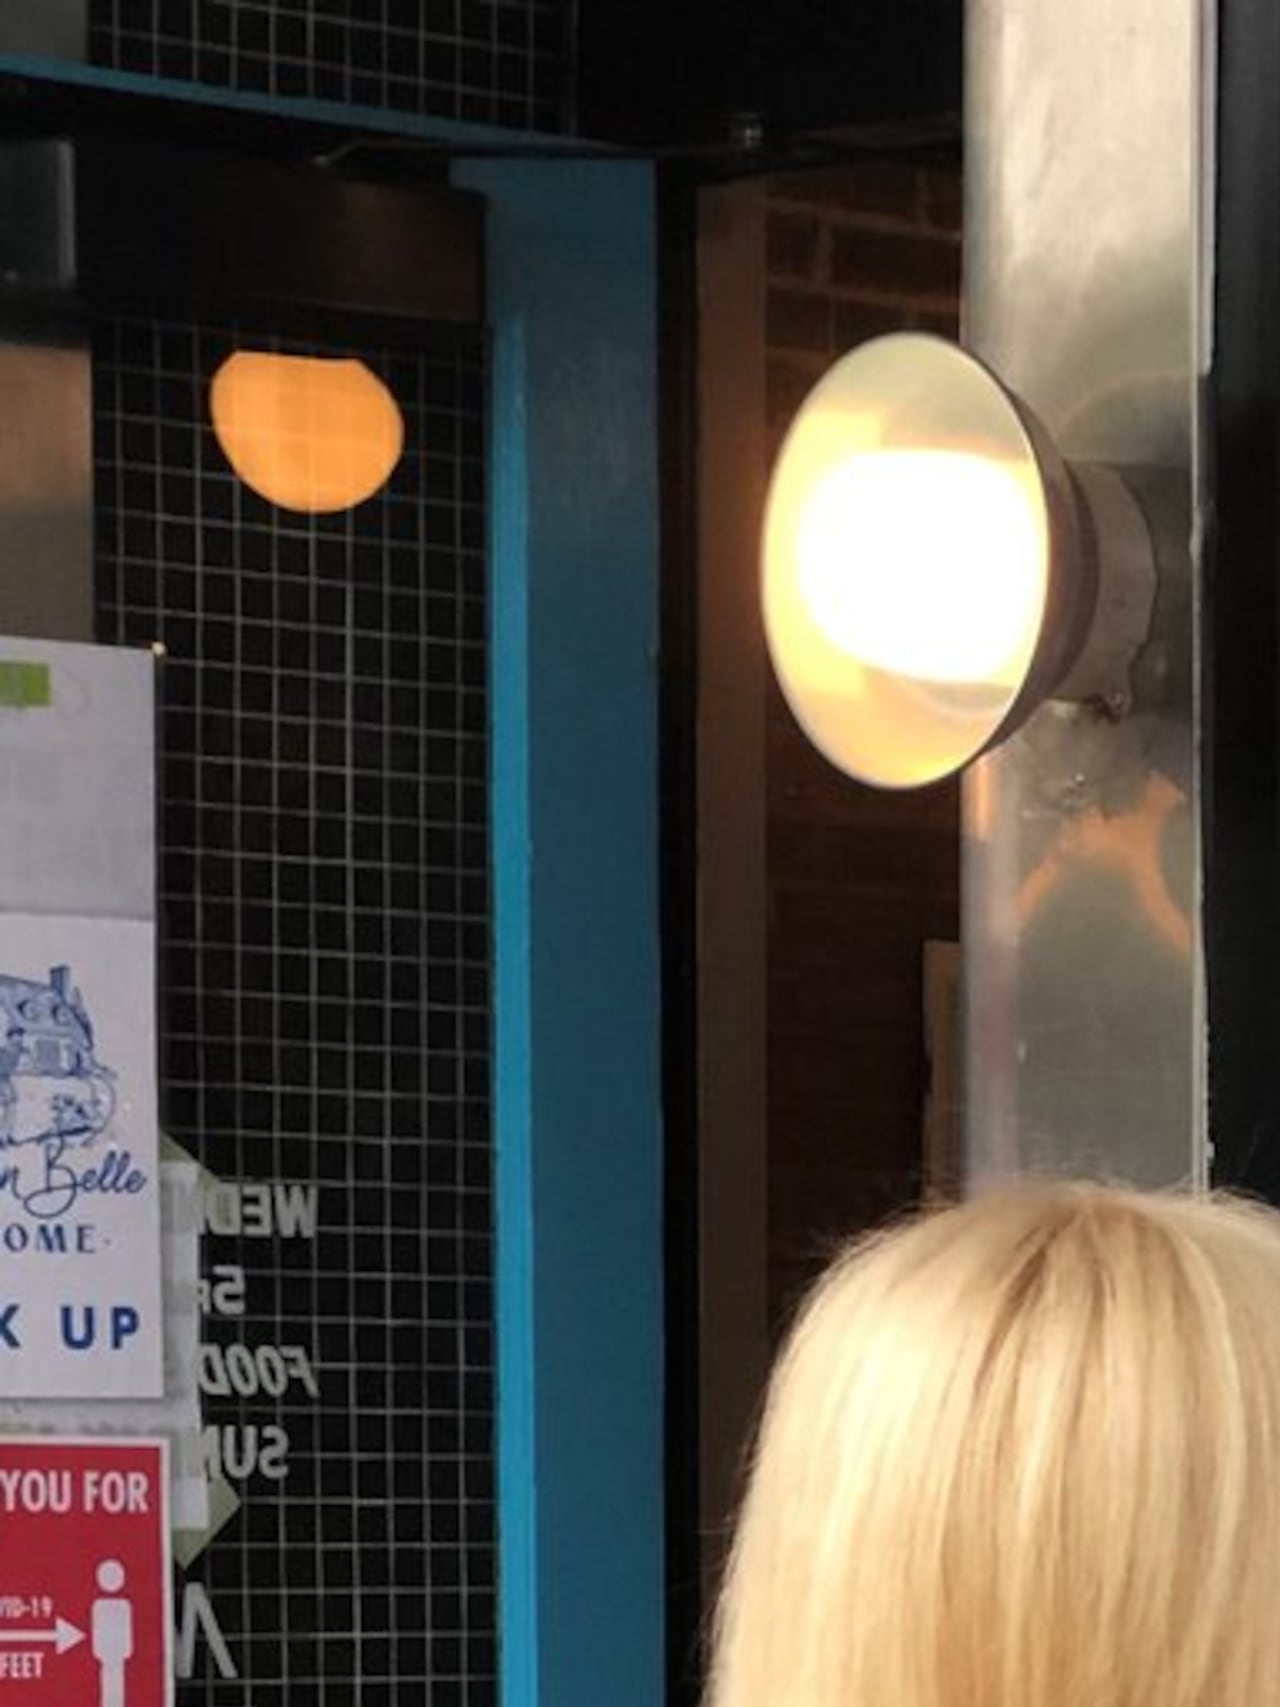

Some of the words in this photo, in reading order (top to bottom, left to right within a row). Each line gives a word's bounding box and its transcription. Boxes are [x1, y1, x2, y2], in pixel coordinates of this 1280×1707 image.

[22, 1136, 148, 1219] Belle
[3, 1223, 97, 1253] OME
[60, 1304, 139, 1350] UP
[84, 1471, 149, 1514] FOR
